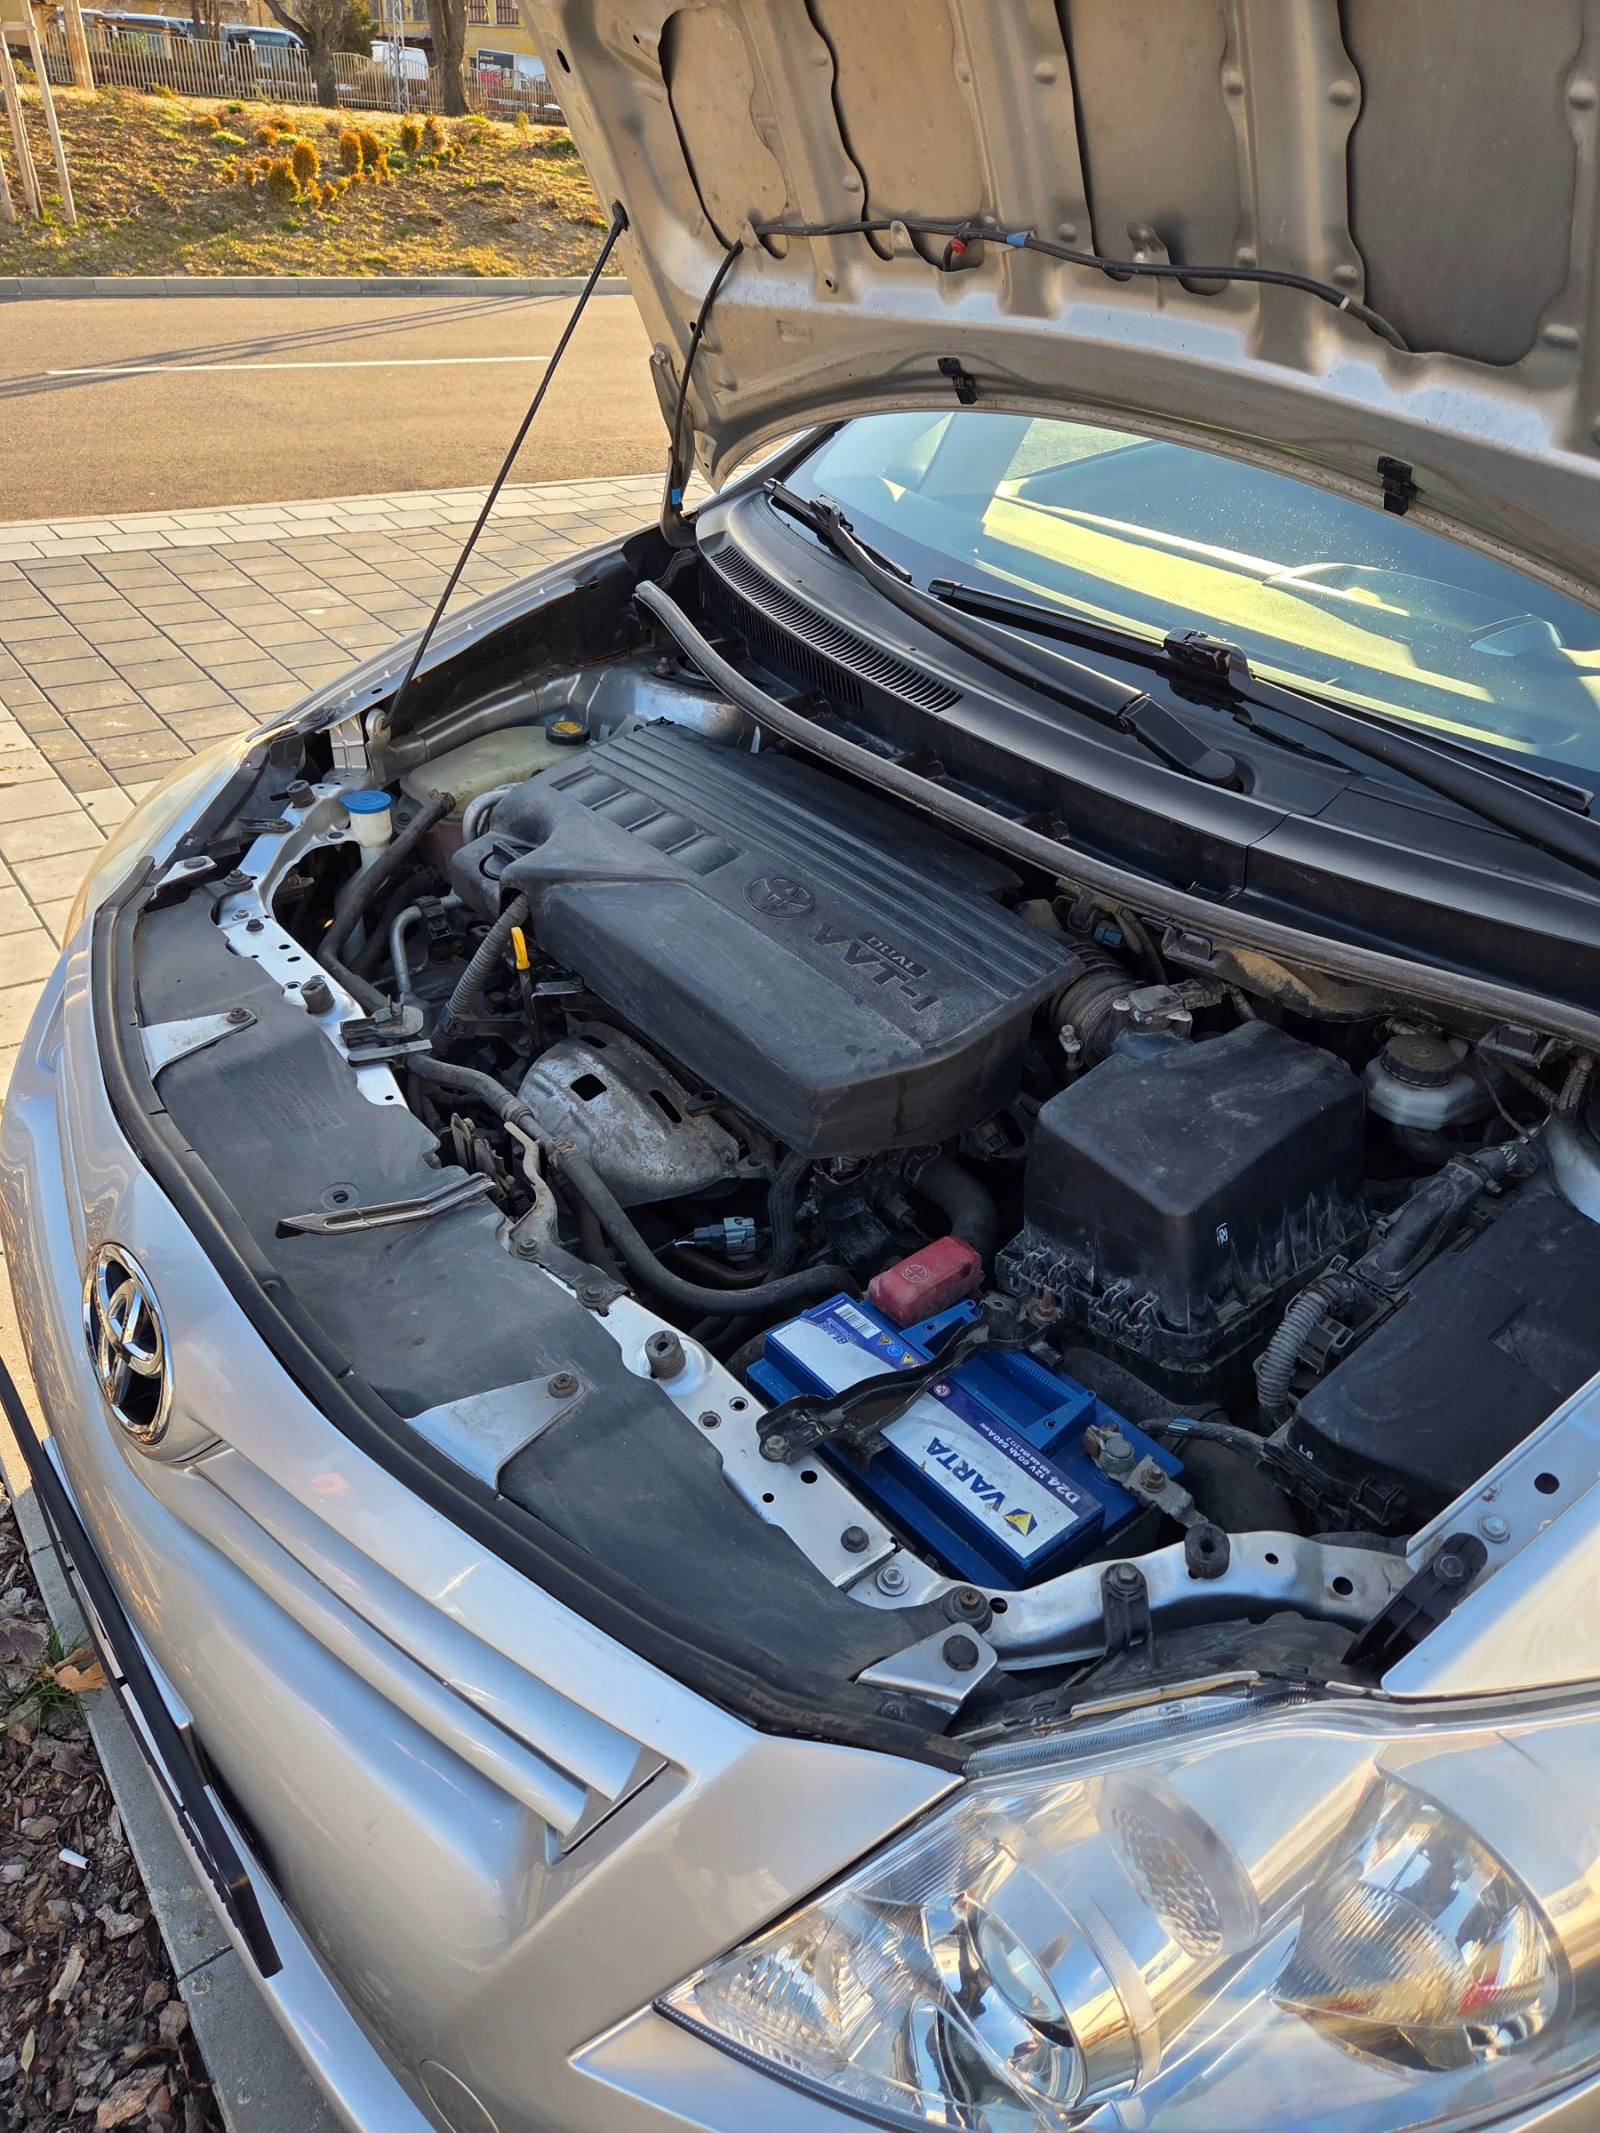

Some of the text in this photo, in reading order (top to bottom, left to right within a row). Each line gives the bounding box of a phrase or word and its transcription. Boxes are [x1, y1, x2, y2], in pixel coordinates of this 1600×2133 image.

[866, 936, 917, 972] DUAL
[1009, 1447, 1030, 1466] 60Ah
[926, 1436, 1006, 1512] VARTA
[1029, 1465, 1046, 1479] 12V
[1047, 1475, 1082, 1505] D24
